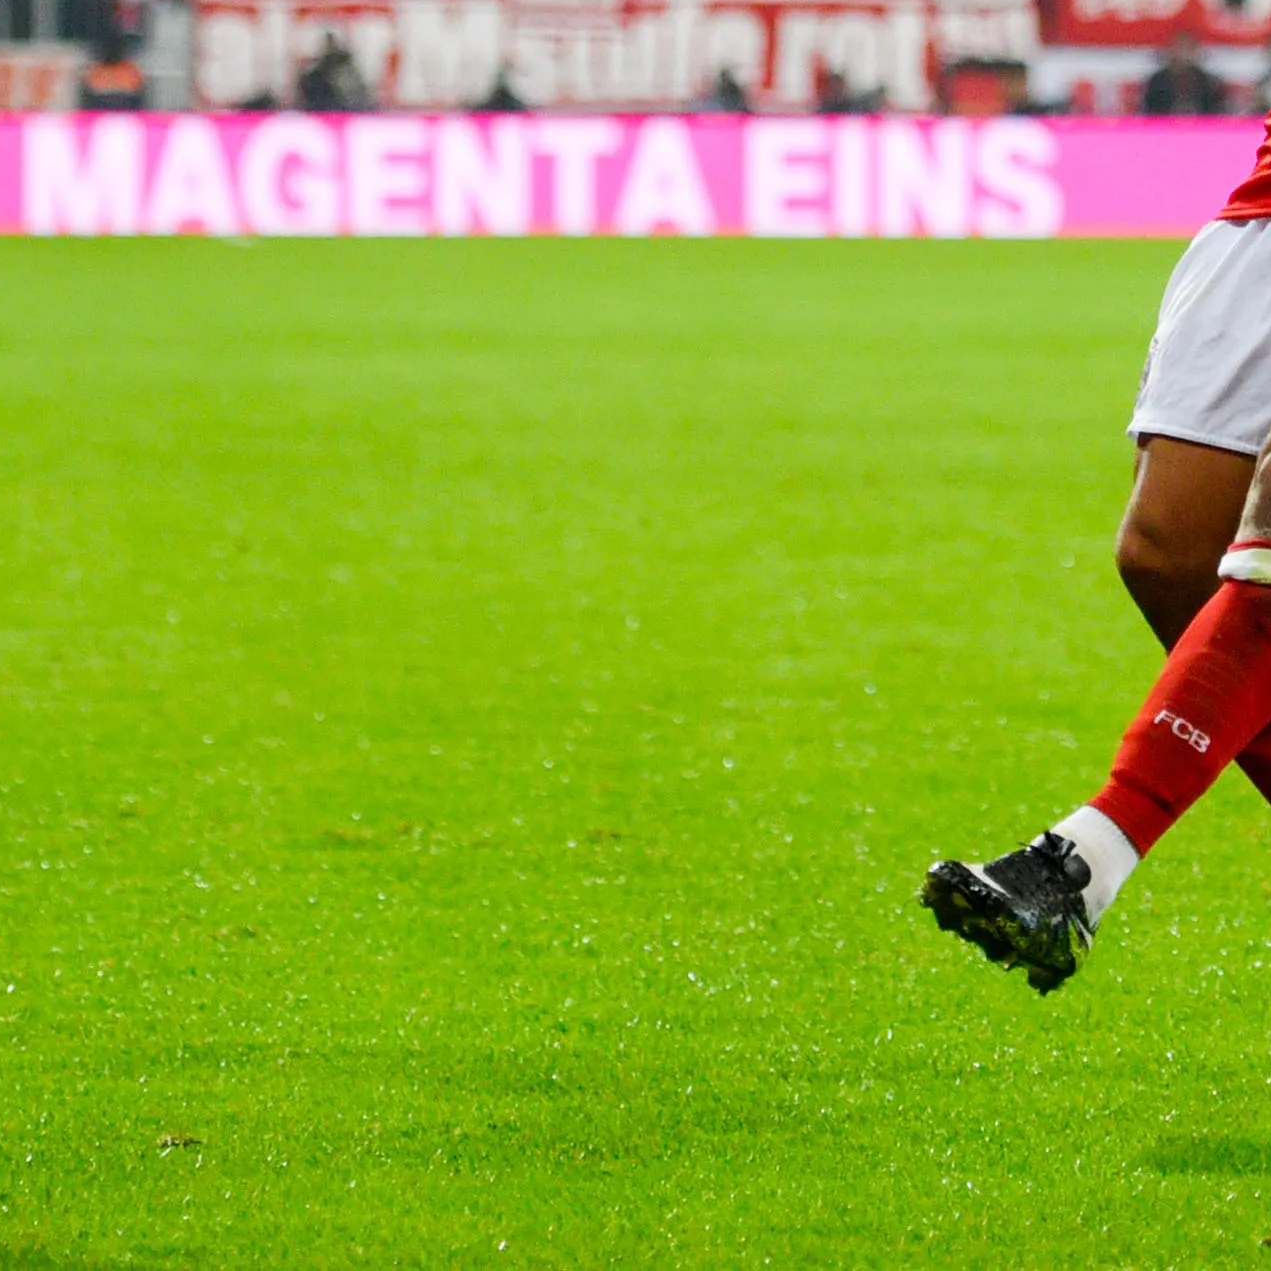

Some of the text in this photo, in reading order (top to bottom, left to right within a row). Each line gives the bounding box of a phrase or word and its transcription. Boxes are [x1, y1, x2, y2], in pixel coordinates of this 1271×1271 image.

[24, 112, 716, 237] MAGENTA
[742, 114, 1065, 238] EINS
[1154, 709, 1212, 754] FCB
